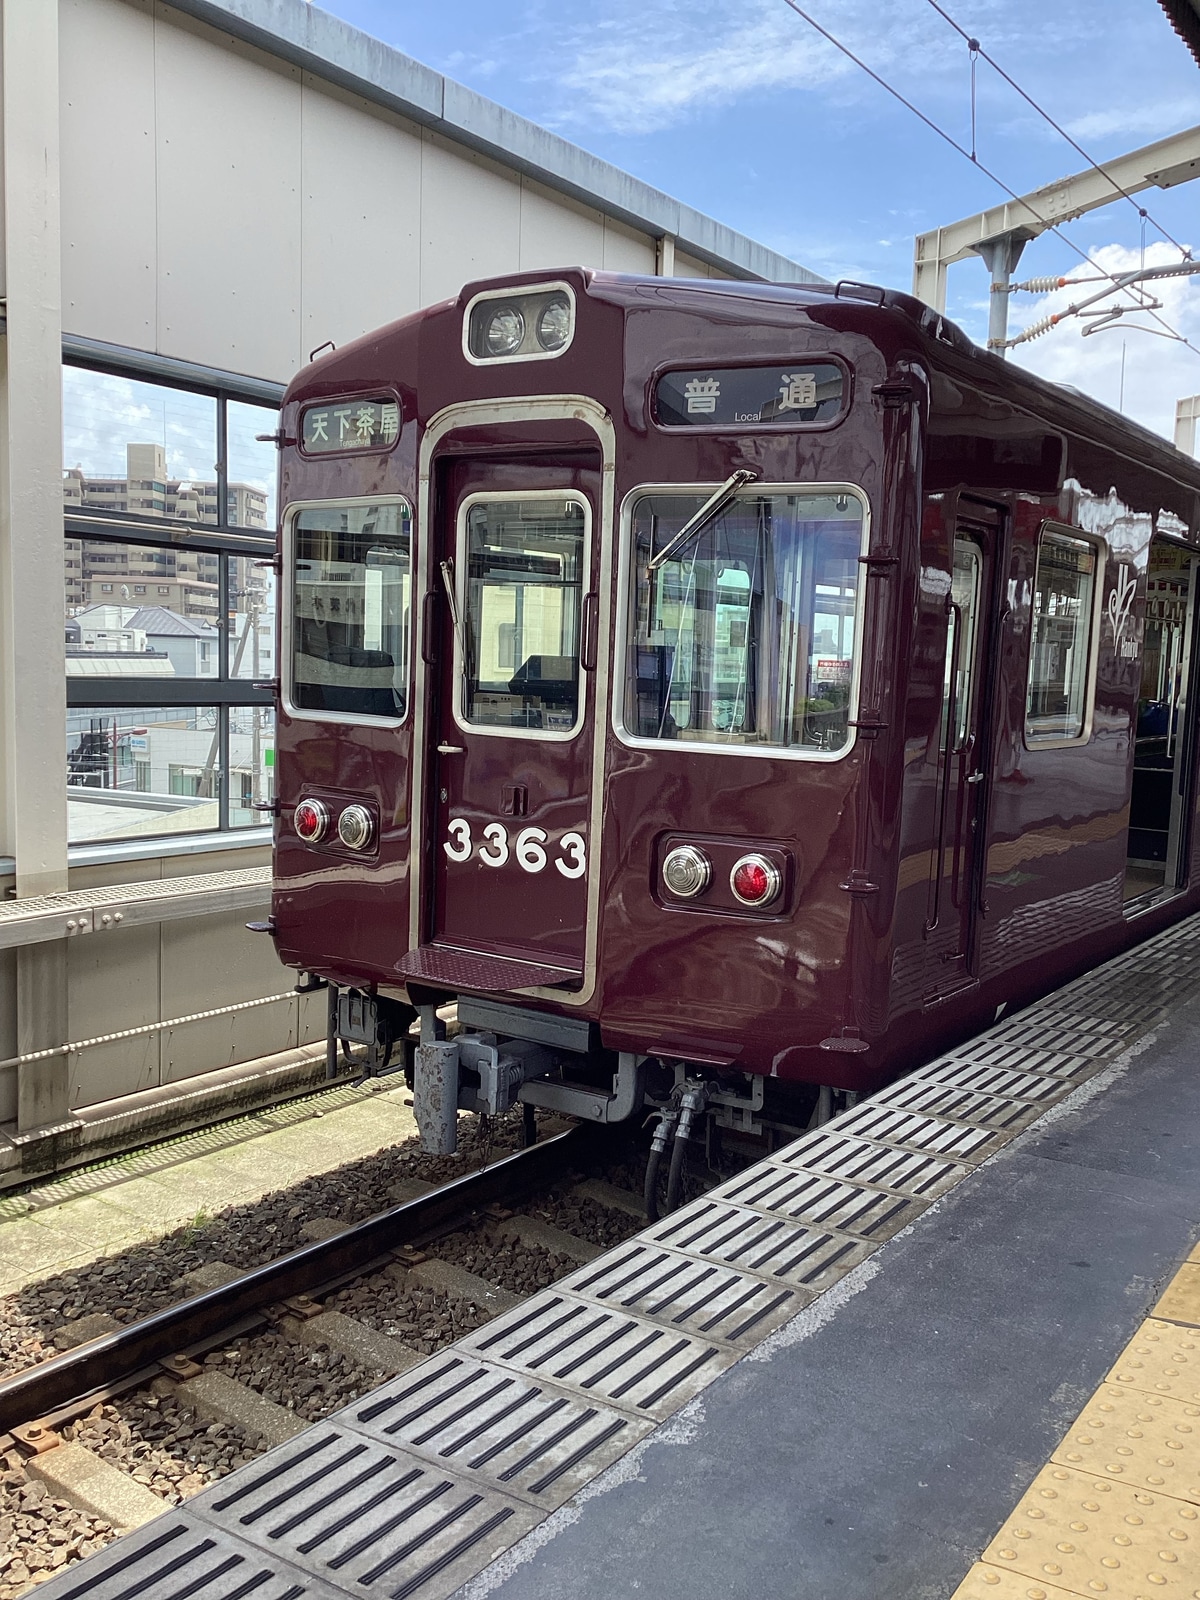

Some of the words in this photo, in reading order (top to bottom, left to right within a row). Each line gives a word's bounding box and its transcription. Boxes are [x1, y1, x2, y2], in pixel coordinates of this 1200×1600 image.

[684, 373, 817, 413] 普通
[311, 402, 398, 442] 天下茶屋
[734, 411, 762, 422] Local
[443, 818, 586, 879] 3363
